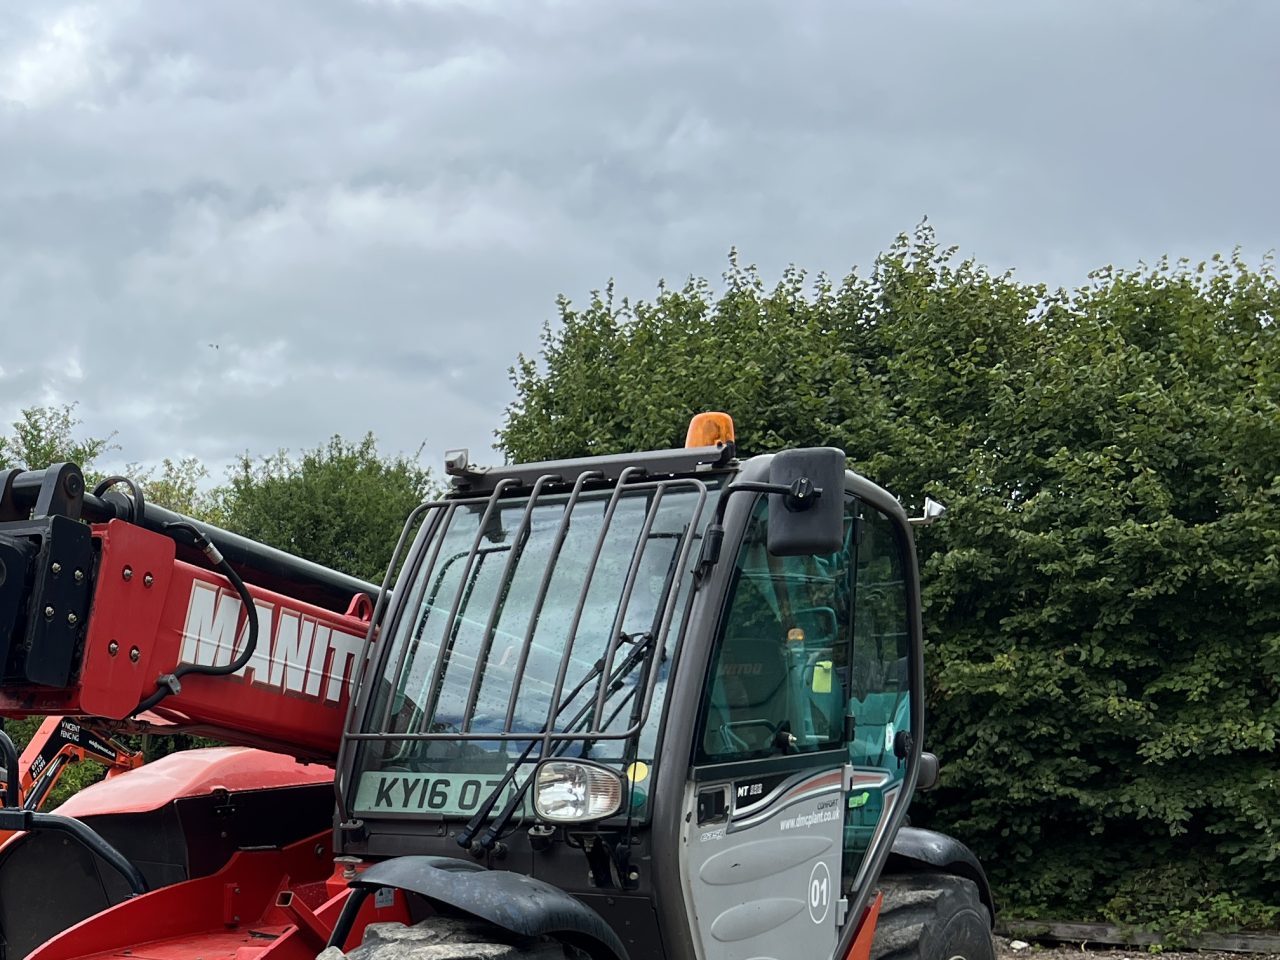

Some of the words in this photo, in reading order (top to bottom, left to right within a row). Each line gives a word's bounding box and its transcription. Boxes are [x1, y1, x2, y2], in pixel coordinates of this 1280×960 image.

[179, 579, 376, 705] MANIT
[374, 777, 451, 809] KY16
[458, 779, 526, 811] OZ
[737, 785, 749, 798] MT
[780, 806, 840, 831] www.dmcplant.co.uk
[811, 877, 827, 907] 01
